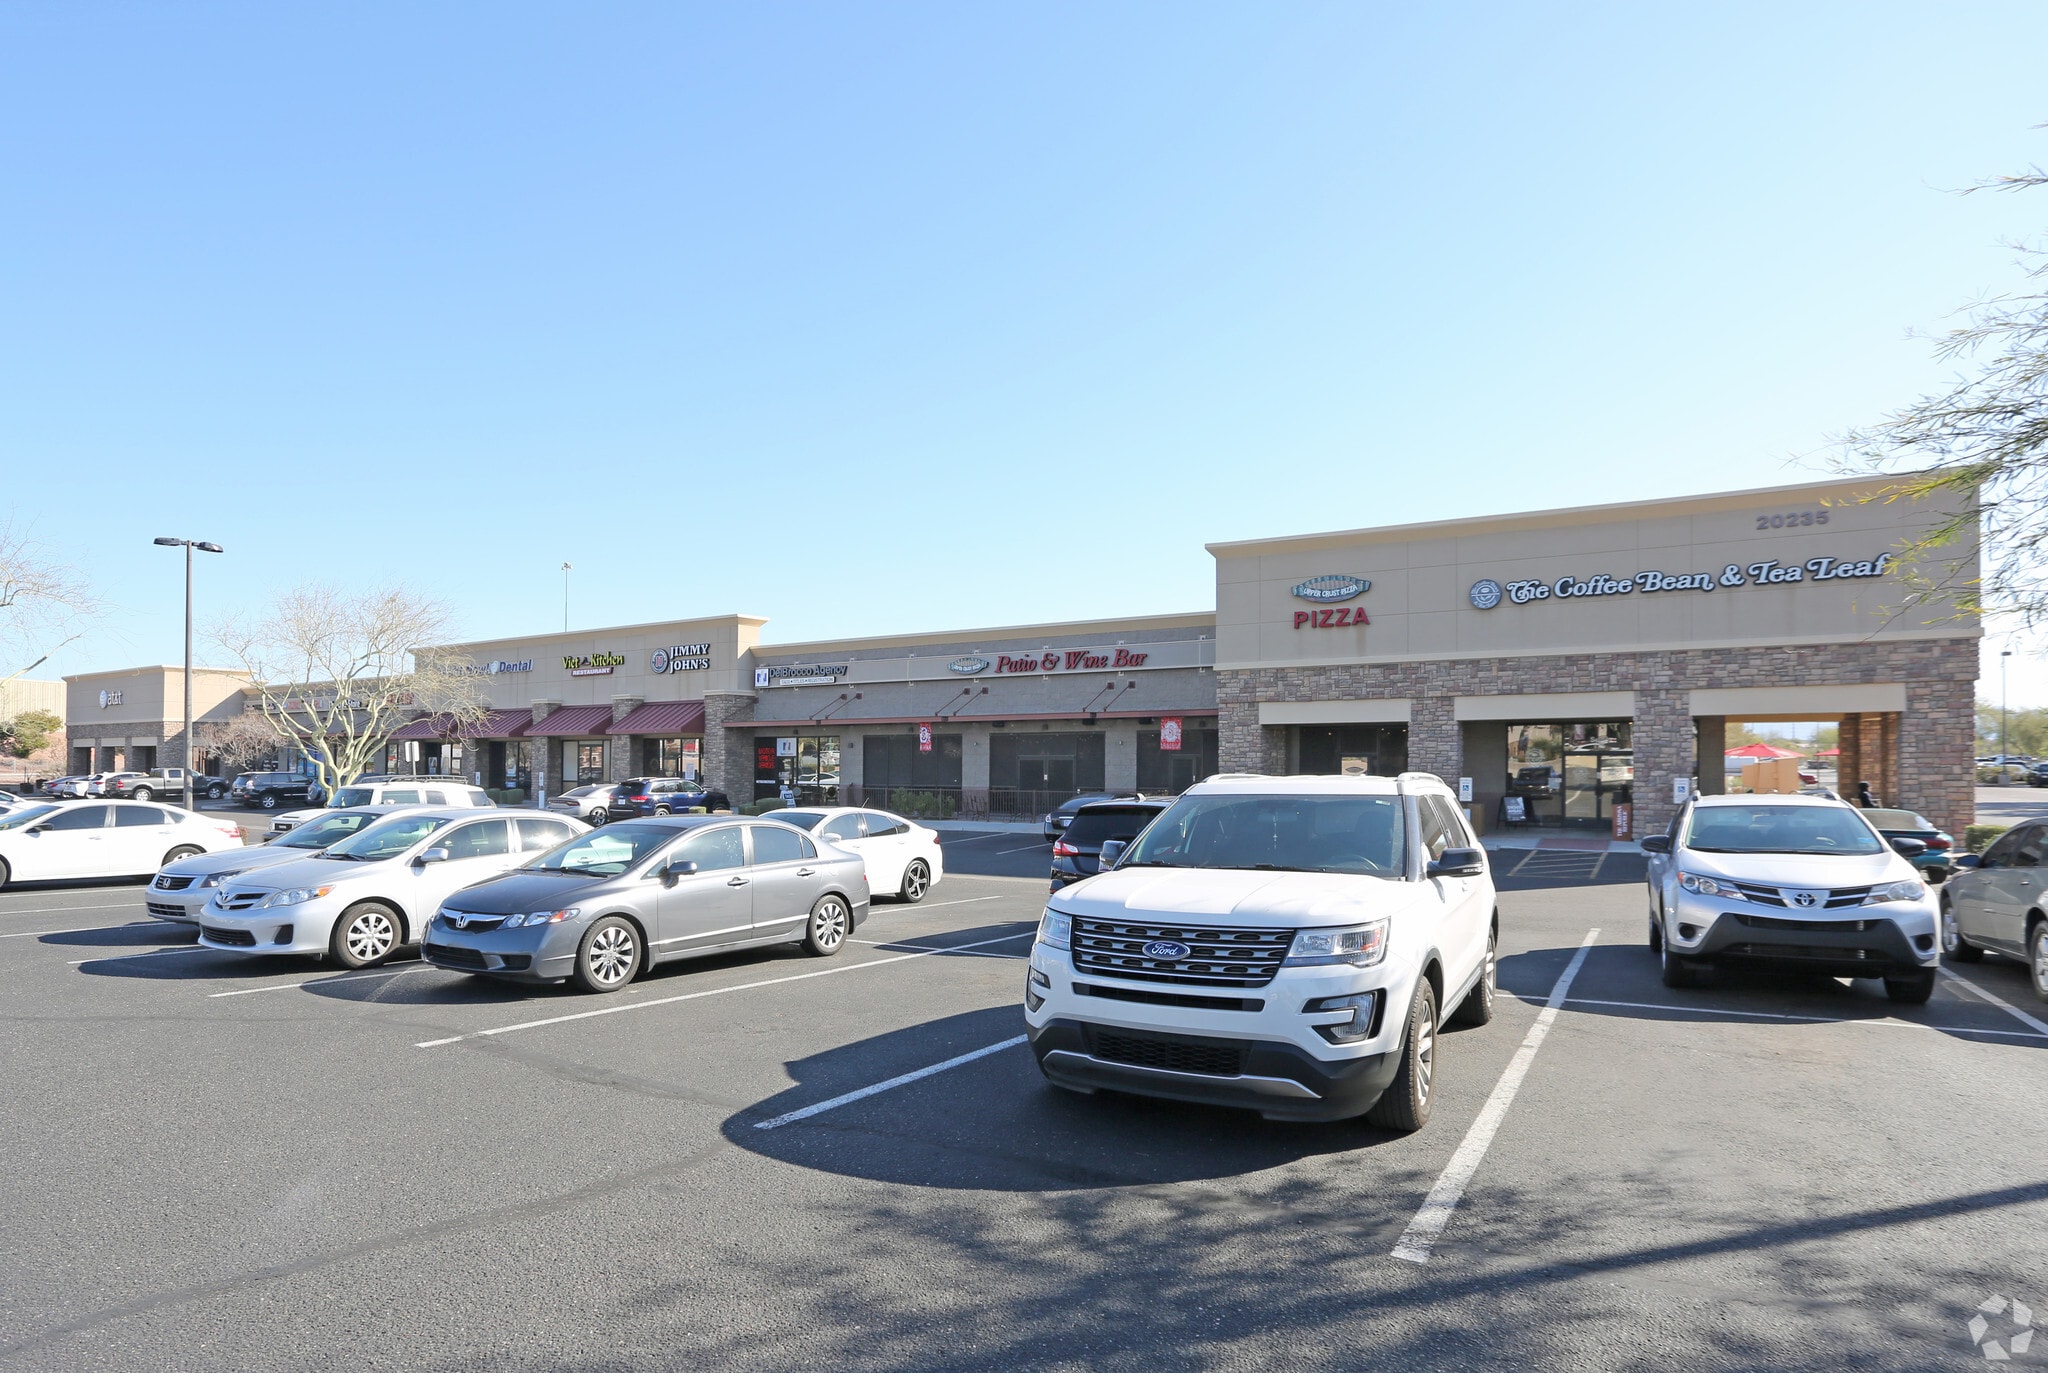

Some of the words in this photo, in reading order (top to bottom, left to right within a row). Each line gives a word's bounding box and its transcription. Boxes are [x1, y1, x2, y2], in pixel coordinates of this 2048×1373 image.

[1756, 510, 1830, 530] 20235
[1506, 580, 1550, 604] The
[1554, 575, 1633, 598] Coffee
[1635, 571, 1715, 592] Bean
[1719, 564, 1745, 587] &
[1748, 561, 1802, 585] Tea
[1806, 553, 1892, 581] Leaf
[1303, 587, 1321, 597] UPPER
[1322, 589, 1340, 598] CRUST
[1341, 584, 1358, 595] PIZZA
[1294, 607, 1370, 629] PIZZA
[562, 656, 580, 669] Viet
[590, 651, 624, 667] Kitchen
[670, 644, 710, 660] JIMMY
[500, 660, 533, 673] Dental
[670, 658, 710, 674] JOHN'S
[994, 655, 1037, 673] Patio
[1040, 653, 1059, 671] &
[1064, 650, 1108, 670] Wine
[1112, 649, 1148, 668] Bar
[572, 668, 611, 676] RESTAURANT
[814, 664, 847, 677] Agency
[108, 690, 122, 705] at&t
[1152, 943, 1178, 955] Ford
